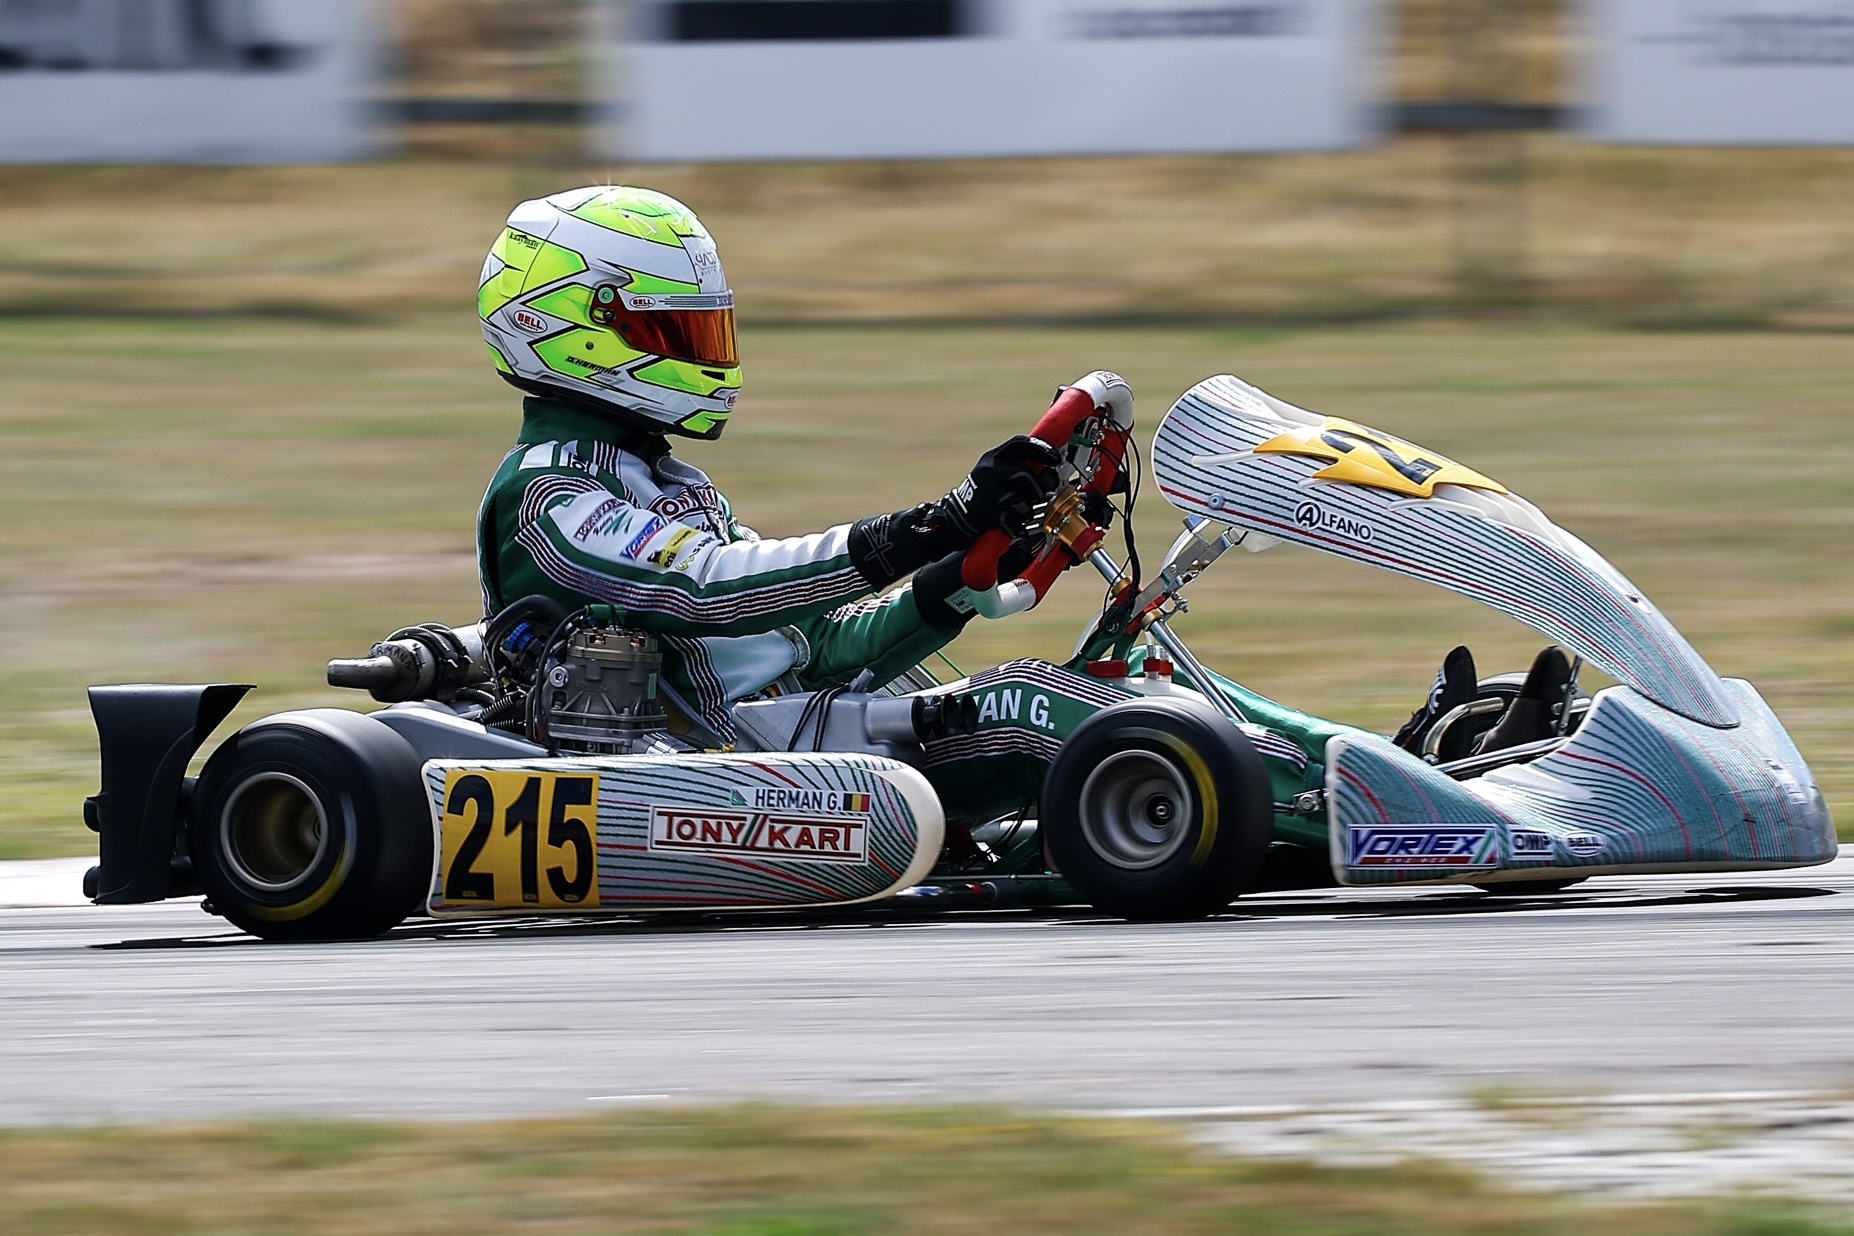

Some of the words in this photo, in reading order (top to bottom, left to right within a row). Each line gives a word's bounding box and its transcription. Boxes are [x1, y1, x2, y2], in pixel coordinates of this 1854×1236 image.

[517, 312, 544, 330] BELL
[1296, 501, 1371, 540] ALFANO
[1029, 694, 1055, 730] G.
[755, 788, 823, 810] HERMAN
[827, 792, 842, 811] G.
[445, 774, 594, 904] 215
[657, 811, 747, 844] TONY
[768, 817, 863, 851] KART
[1351, 828, 1487, 862] VORTEX
[1513, 833, 1551, 850] OMP
[1567, 837, 1602, 849] BELL
